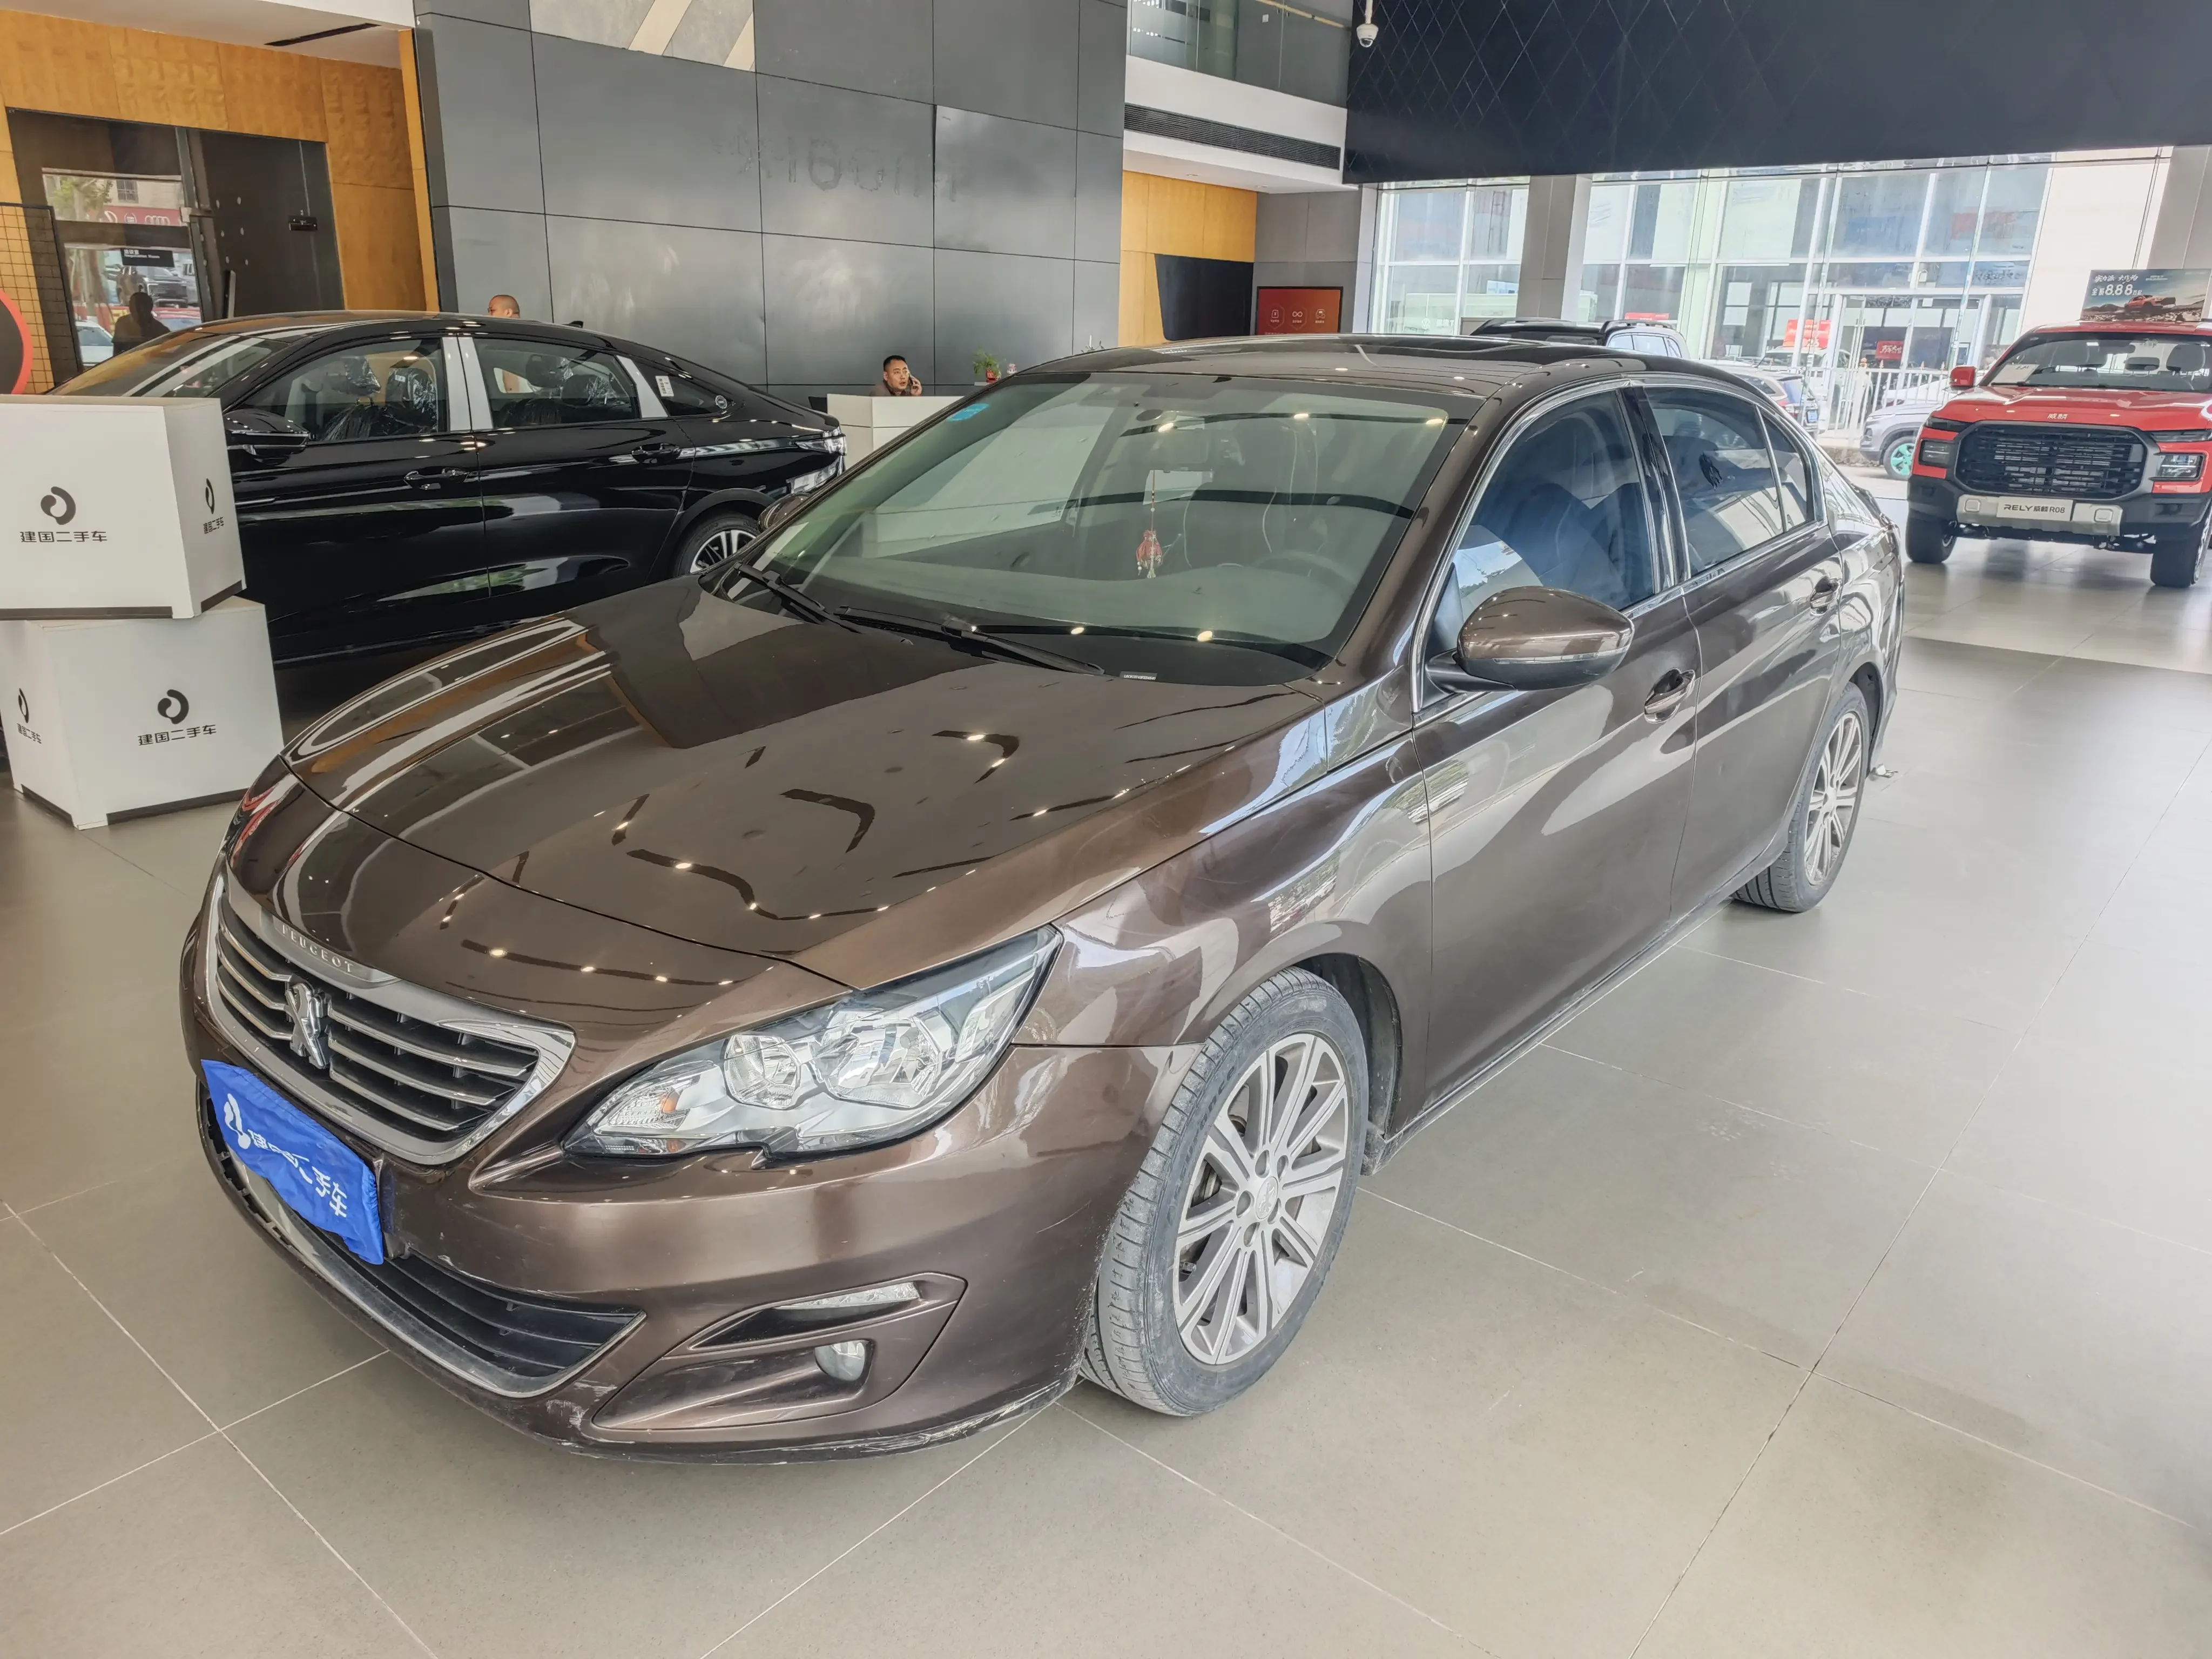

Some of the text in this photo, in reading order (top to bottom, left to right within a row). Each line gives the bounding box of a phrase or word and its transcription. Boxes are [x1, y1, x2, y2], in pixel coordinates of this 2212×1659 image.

[20, 531, 107, 542] 建国二手车
[138, 724, 216, 745] 建国二手车
[282, 924, 353, 972] PEUGEOT
